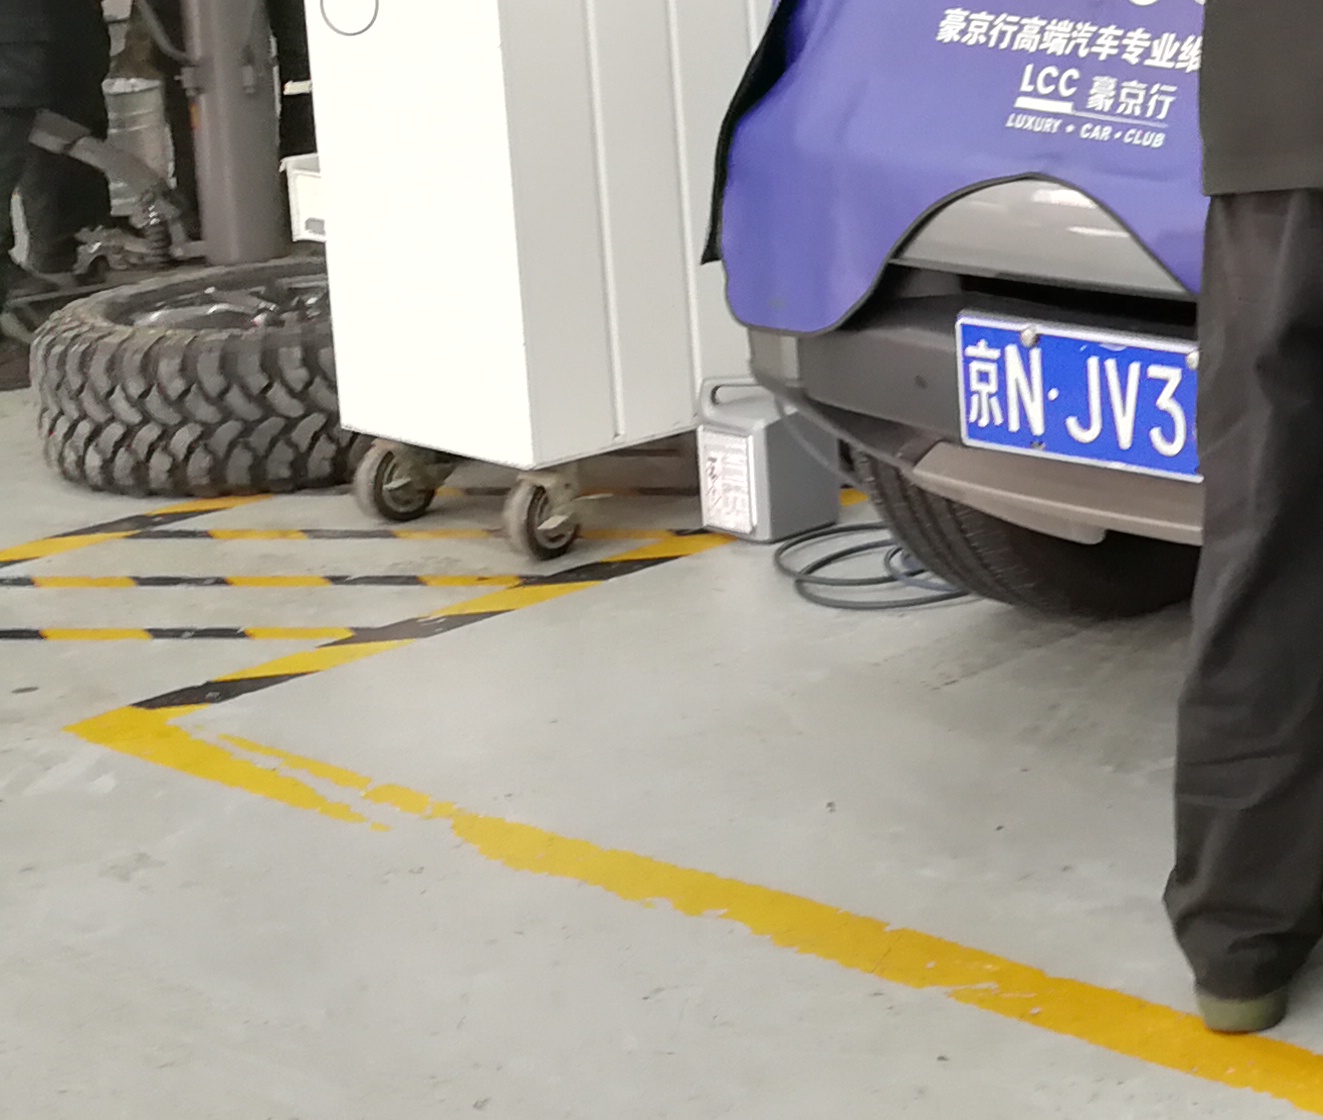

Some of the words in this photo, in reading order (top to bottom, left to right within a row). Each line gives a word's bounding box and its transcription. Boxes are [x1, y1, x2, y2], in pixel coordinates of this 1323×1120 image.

[1019, 63, 1081, 97] LCC
[1086, 75, 1178, 120] 豪京行
[1005, 113, 1063, 134] LUXURY
[1080, 123, 1113, 142] CAR
[1123, 128, 1167, 149] CLUB
